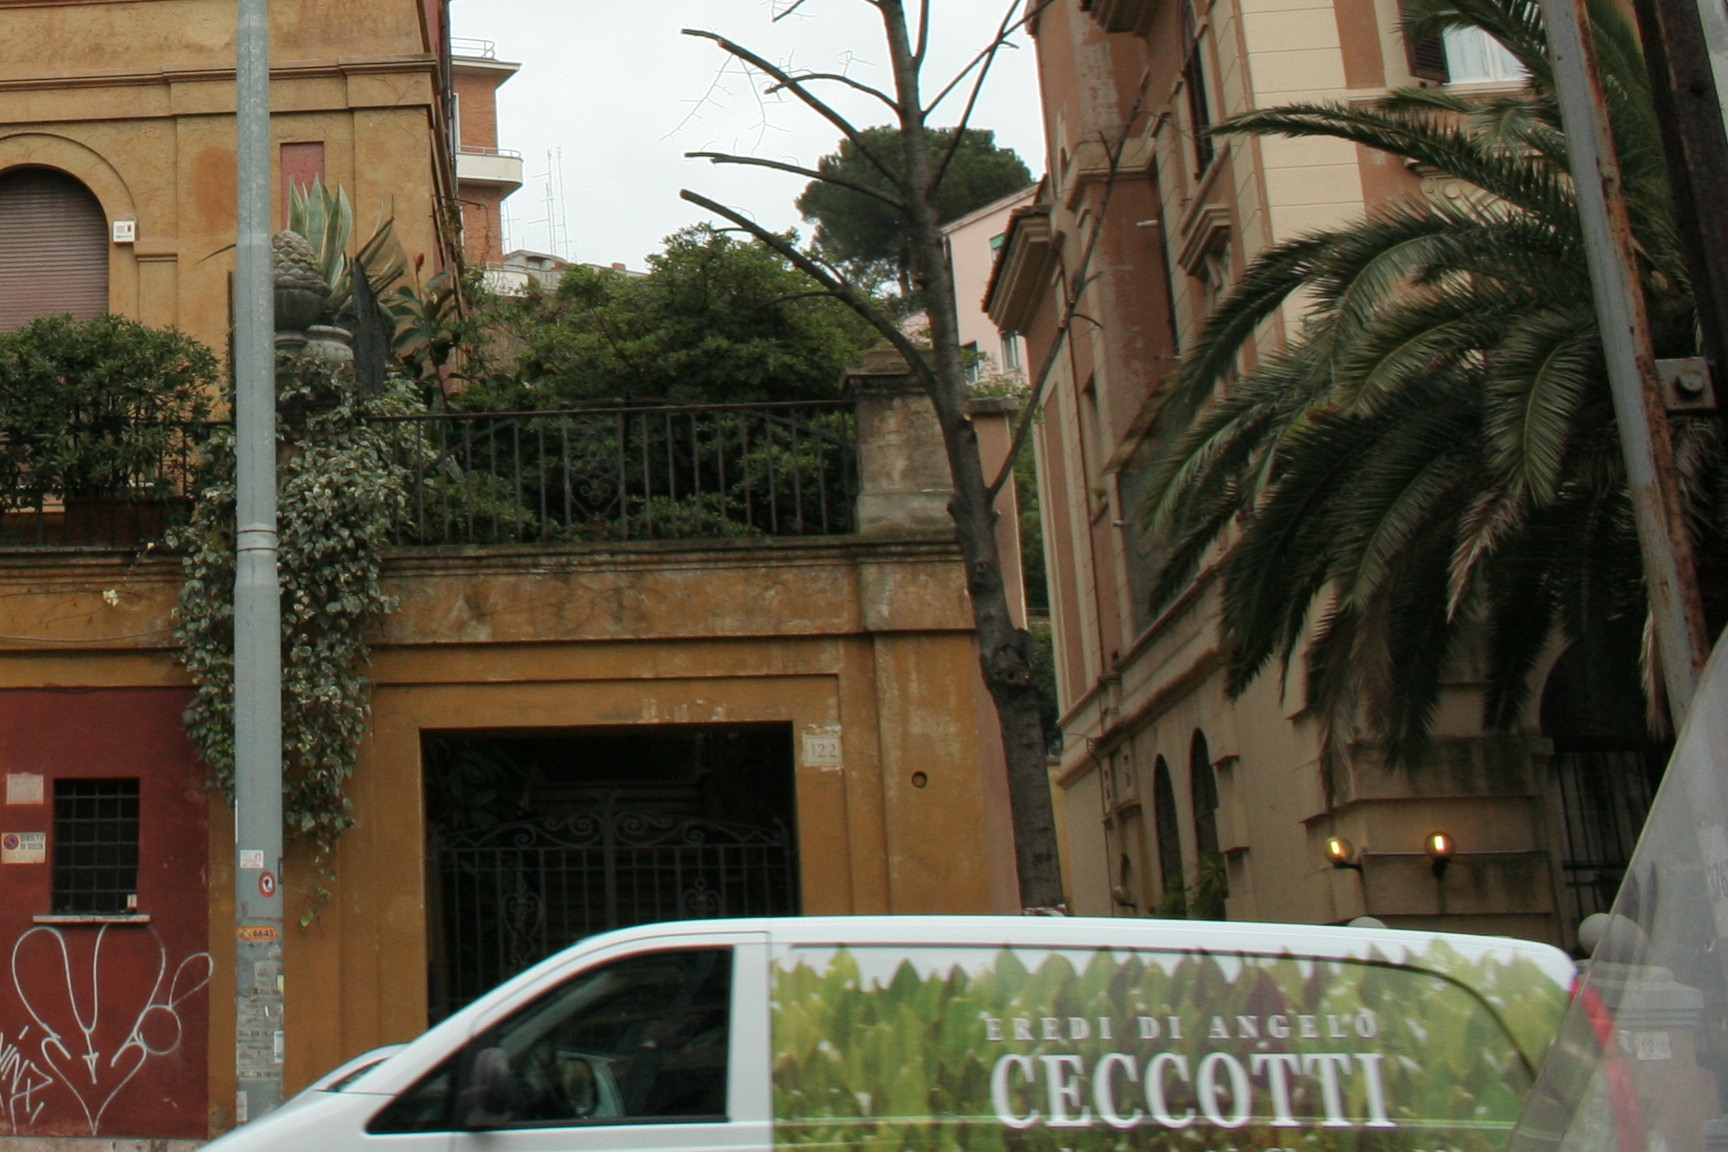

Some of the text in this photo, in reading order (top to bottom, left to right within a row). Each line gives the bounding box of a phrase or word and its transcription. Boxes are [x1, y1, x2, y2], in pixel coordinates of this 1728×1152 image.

[811, 743, 838, 759] 122
[985, 1011, 1379, 1041] EREDI DI ANGELO
[990, 1051, 1398, 1129] CECCOTTI
